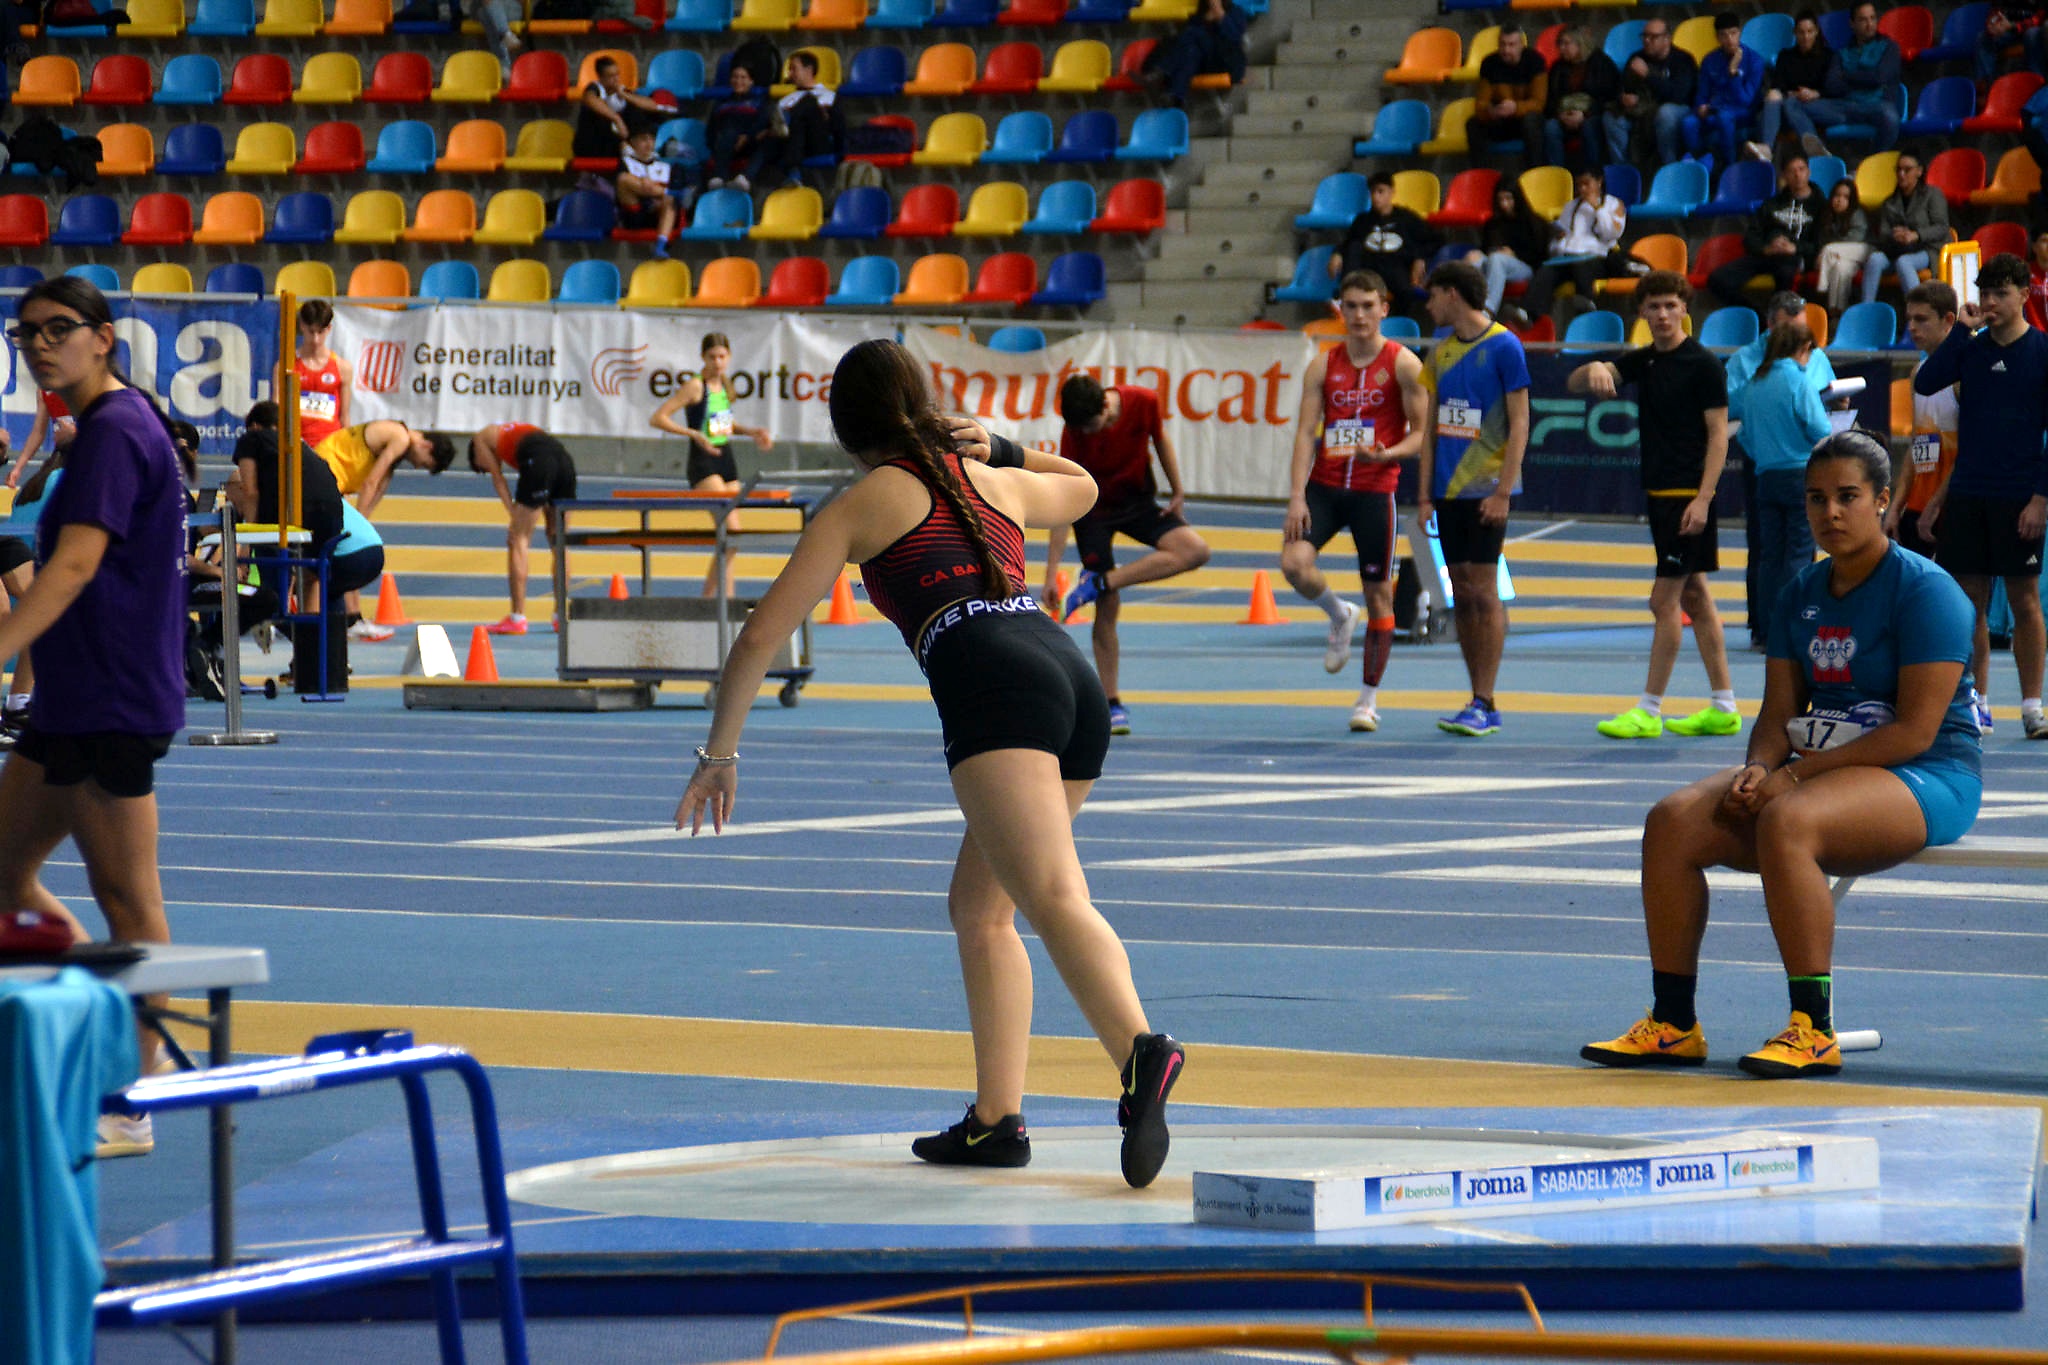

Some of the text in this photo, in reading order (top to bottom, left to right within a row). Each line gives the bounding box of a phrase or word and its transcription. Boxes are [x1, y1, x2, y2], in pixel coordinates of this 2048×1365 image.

[413, 342, 556, 367] Generalitat
[412, 373, 582, 401] de Catalunya
[1448, 410, 1466, 425] 15
[1333, 428, 1366, 446] 158
[1805, 719, 1836, 750] 17
[1539, 1165, 1644, 1194] SABADELL 2025
